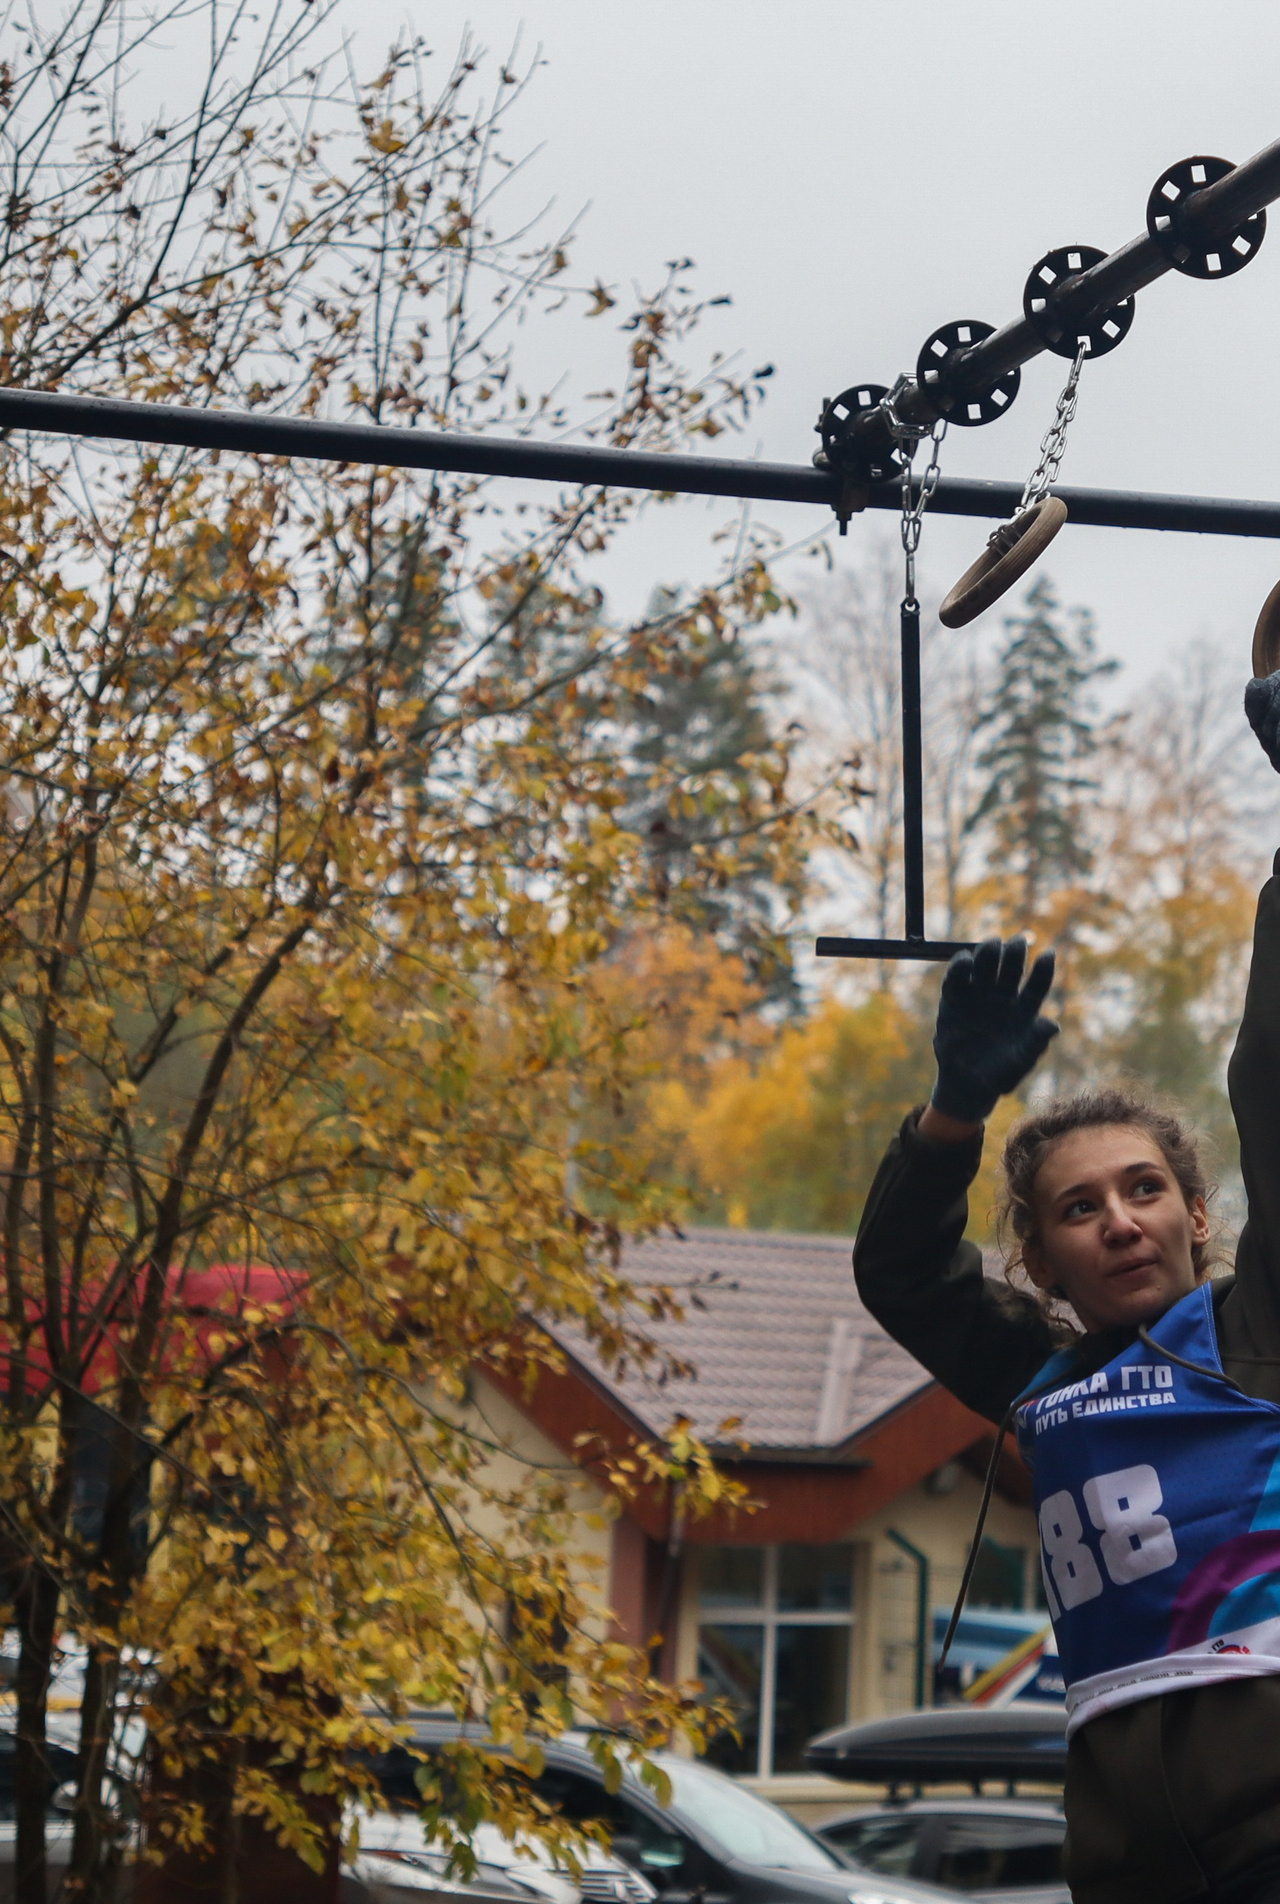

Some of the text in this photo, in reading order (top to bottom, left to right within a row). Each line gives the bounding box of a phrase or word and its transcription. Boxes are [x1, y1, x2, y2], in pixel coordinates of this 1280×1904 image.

[1035, 1365, 1174, 1415] ГОНКА ГТО
[1035, 1392, 1177, 1436] ПУТЬ ЕДИНСТВА
[1038, 1464, 1178, 1623] 88
